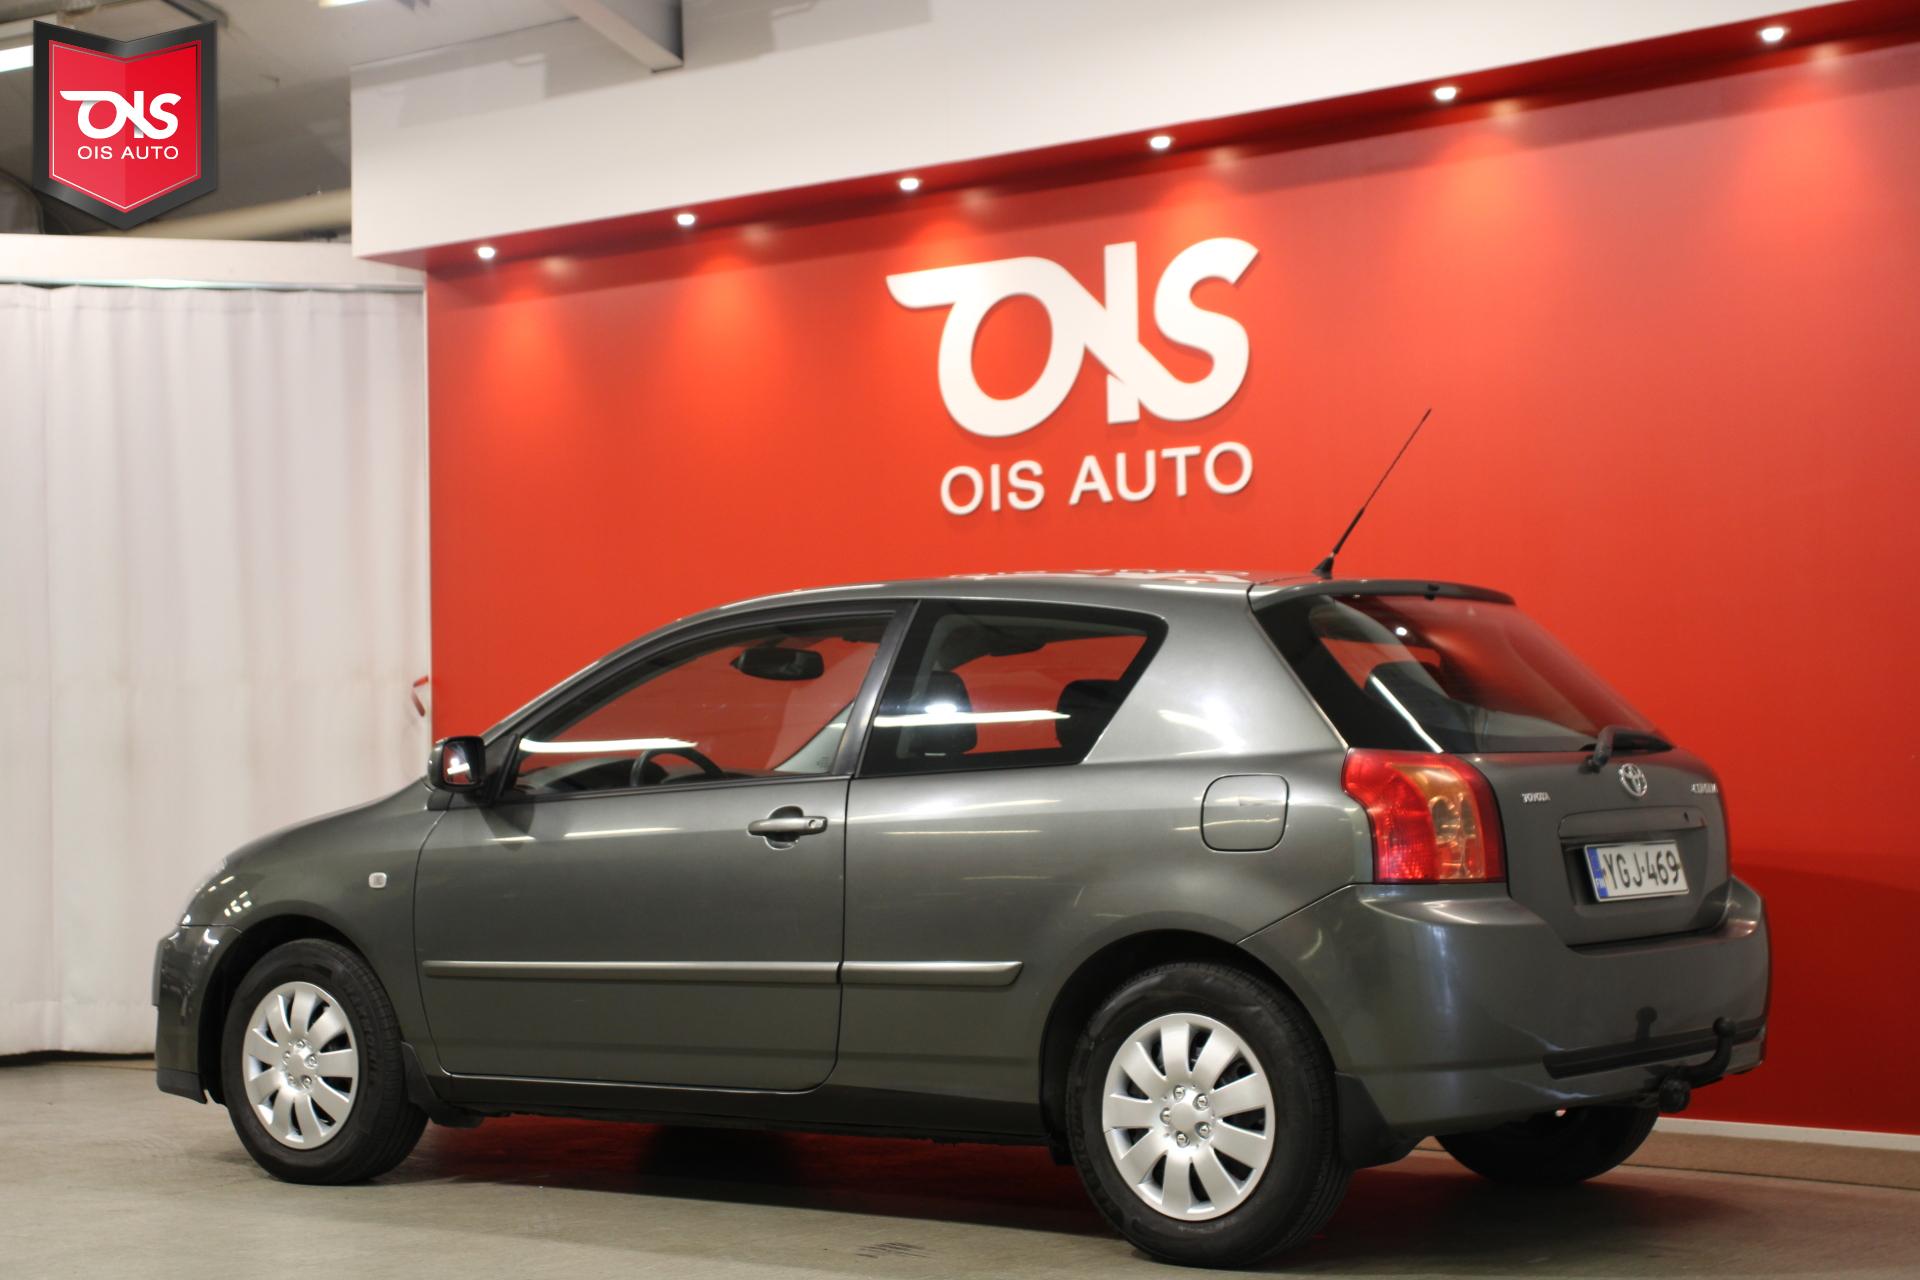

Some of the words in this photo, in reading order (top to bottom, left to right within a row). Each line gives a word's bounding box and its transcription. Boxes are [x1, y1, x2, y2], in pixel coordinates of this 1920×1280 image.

[885, 236, 1260, 438] OIS
[940, 459, 1046, 516] OIS
[1068, 441, 1254, 506] AUTO
[1602, 849, 1681, 890] YGJ-469
